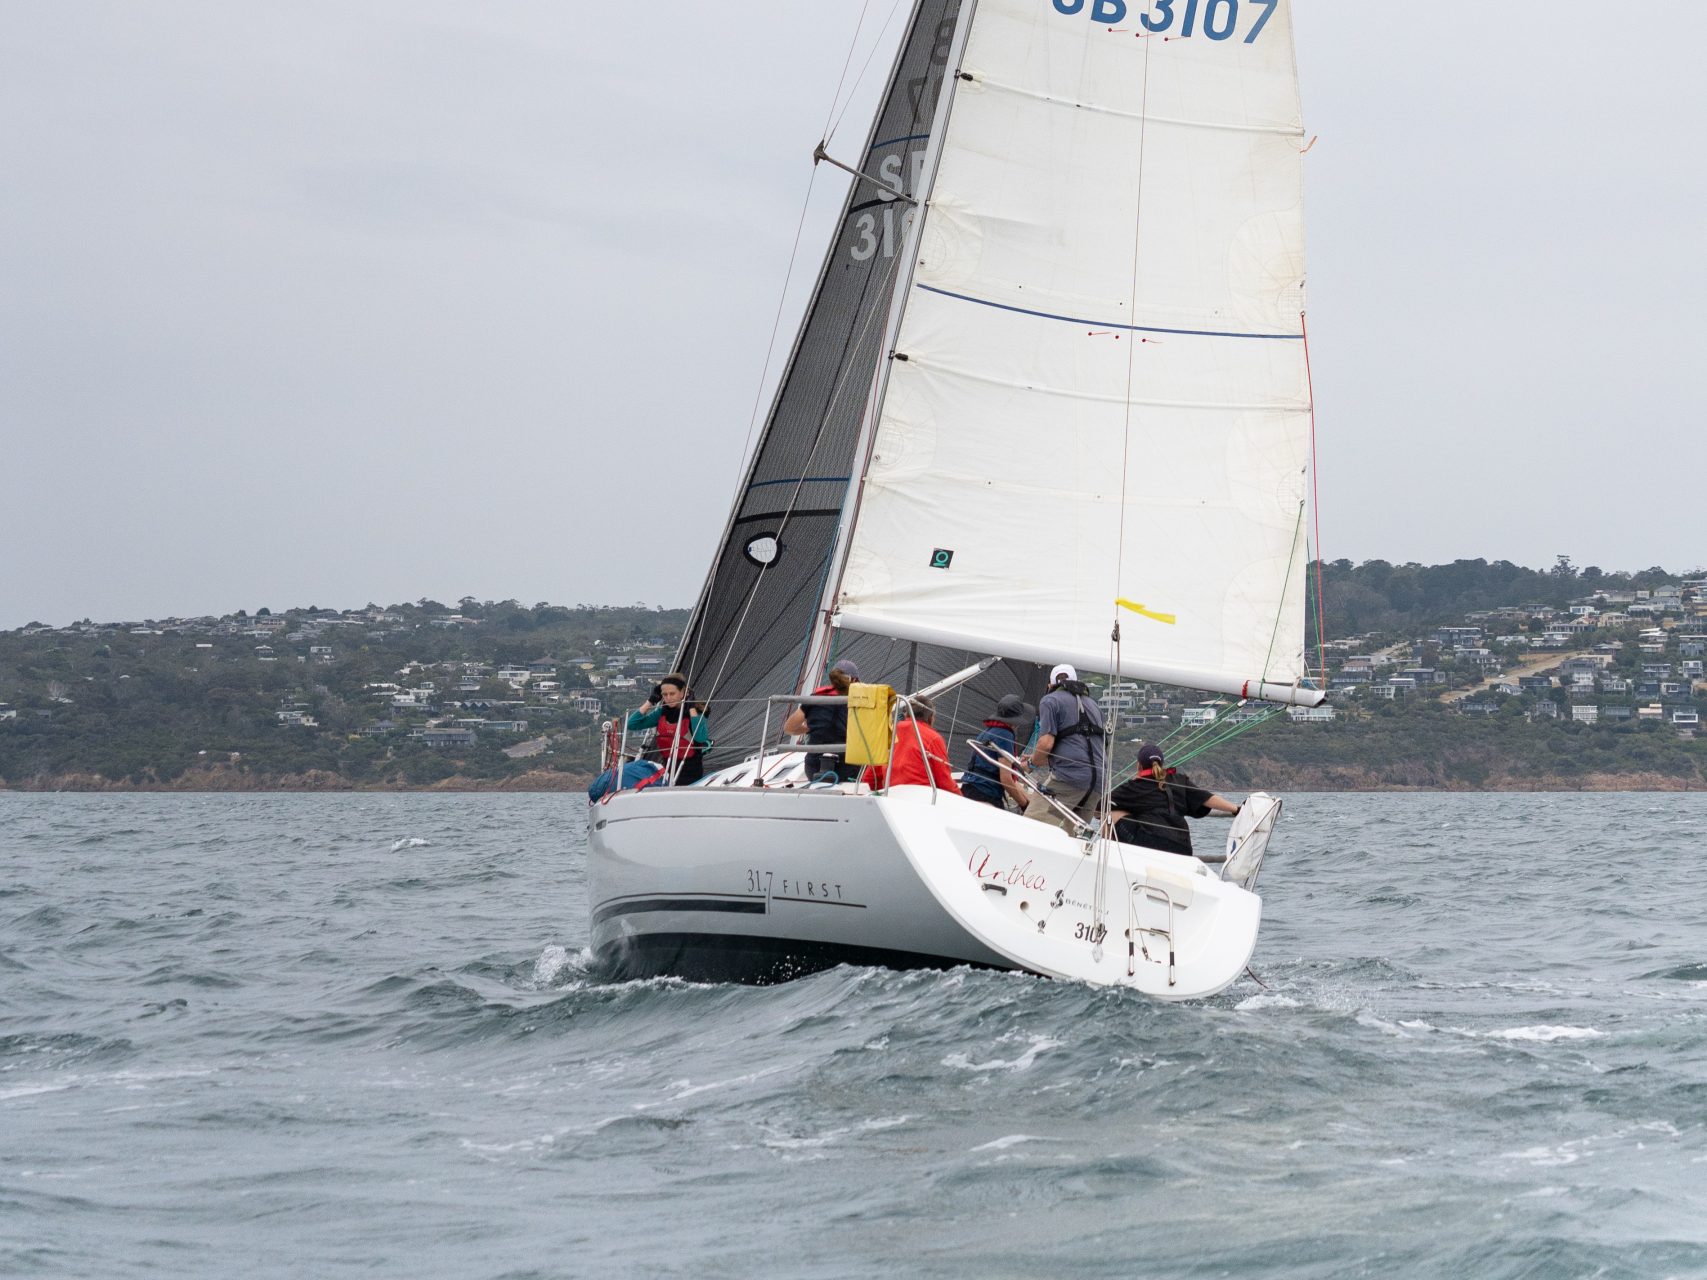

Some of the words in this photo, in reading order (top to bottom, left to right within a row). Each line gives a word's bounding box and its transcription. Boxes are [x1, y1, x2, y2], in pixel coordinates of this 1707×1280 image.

[968, 844, 1048, 892] Anthea
[747, 869, 773, 914] 31.7
[783, 879, 842, 899] FIRST
